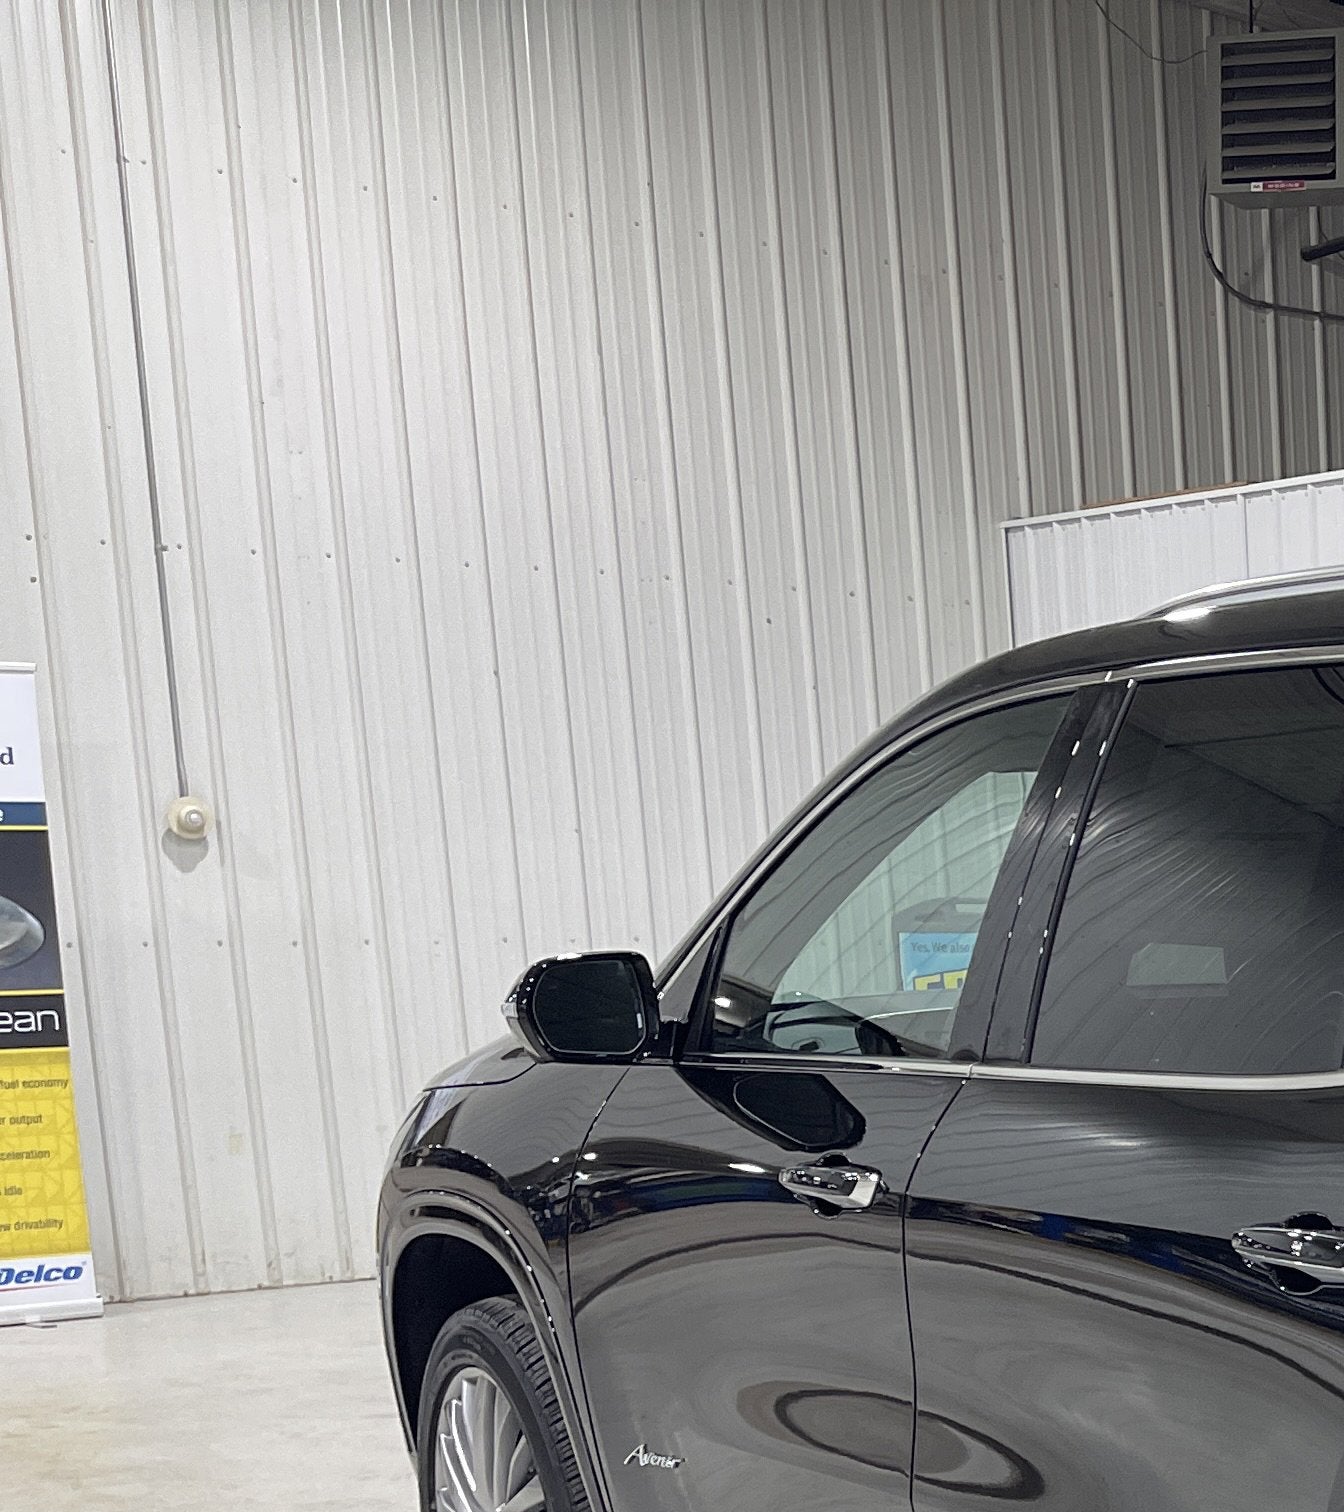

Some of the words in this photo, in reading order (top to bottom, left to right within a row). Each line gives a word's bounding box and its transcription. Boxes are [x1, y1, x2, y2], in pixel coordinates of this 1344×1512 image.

[931, 942, 948, 953] We
[950, 942, 970, 953] also
[22, 1079, 69, 1090] economy
[9, 1114, 43, 1126] output
[14, 1218, 64, 1232] drivability
